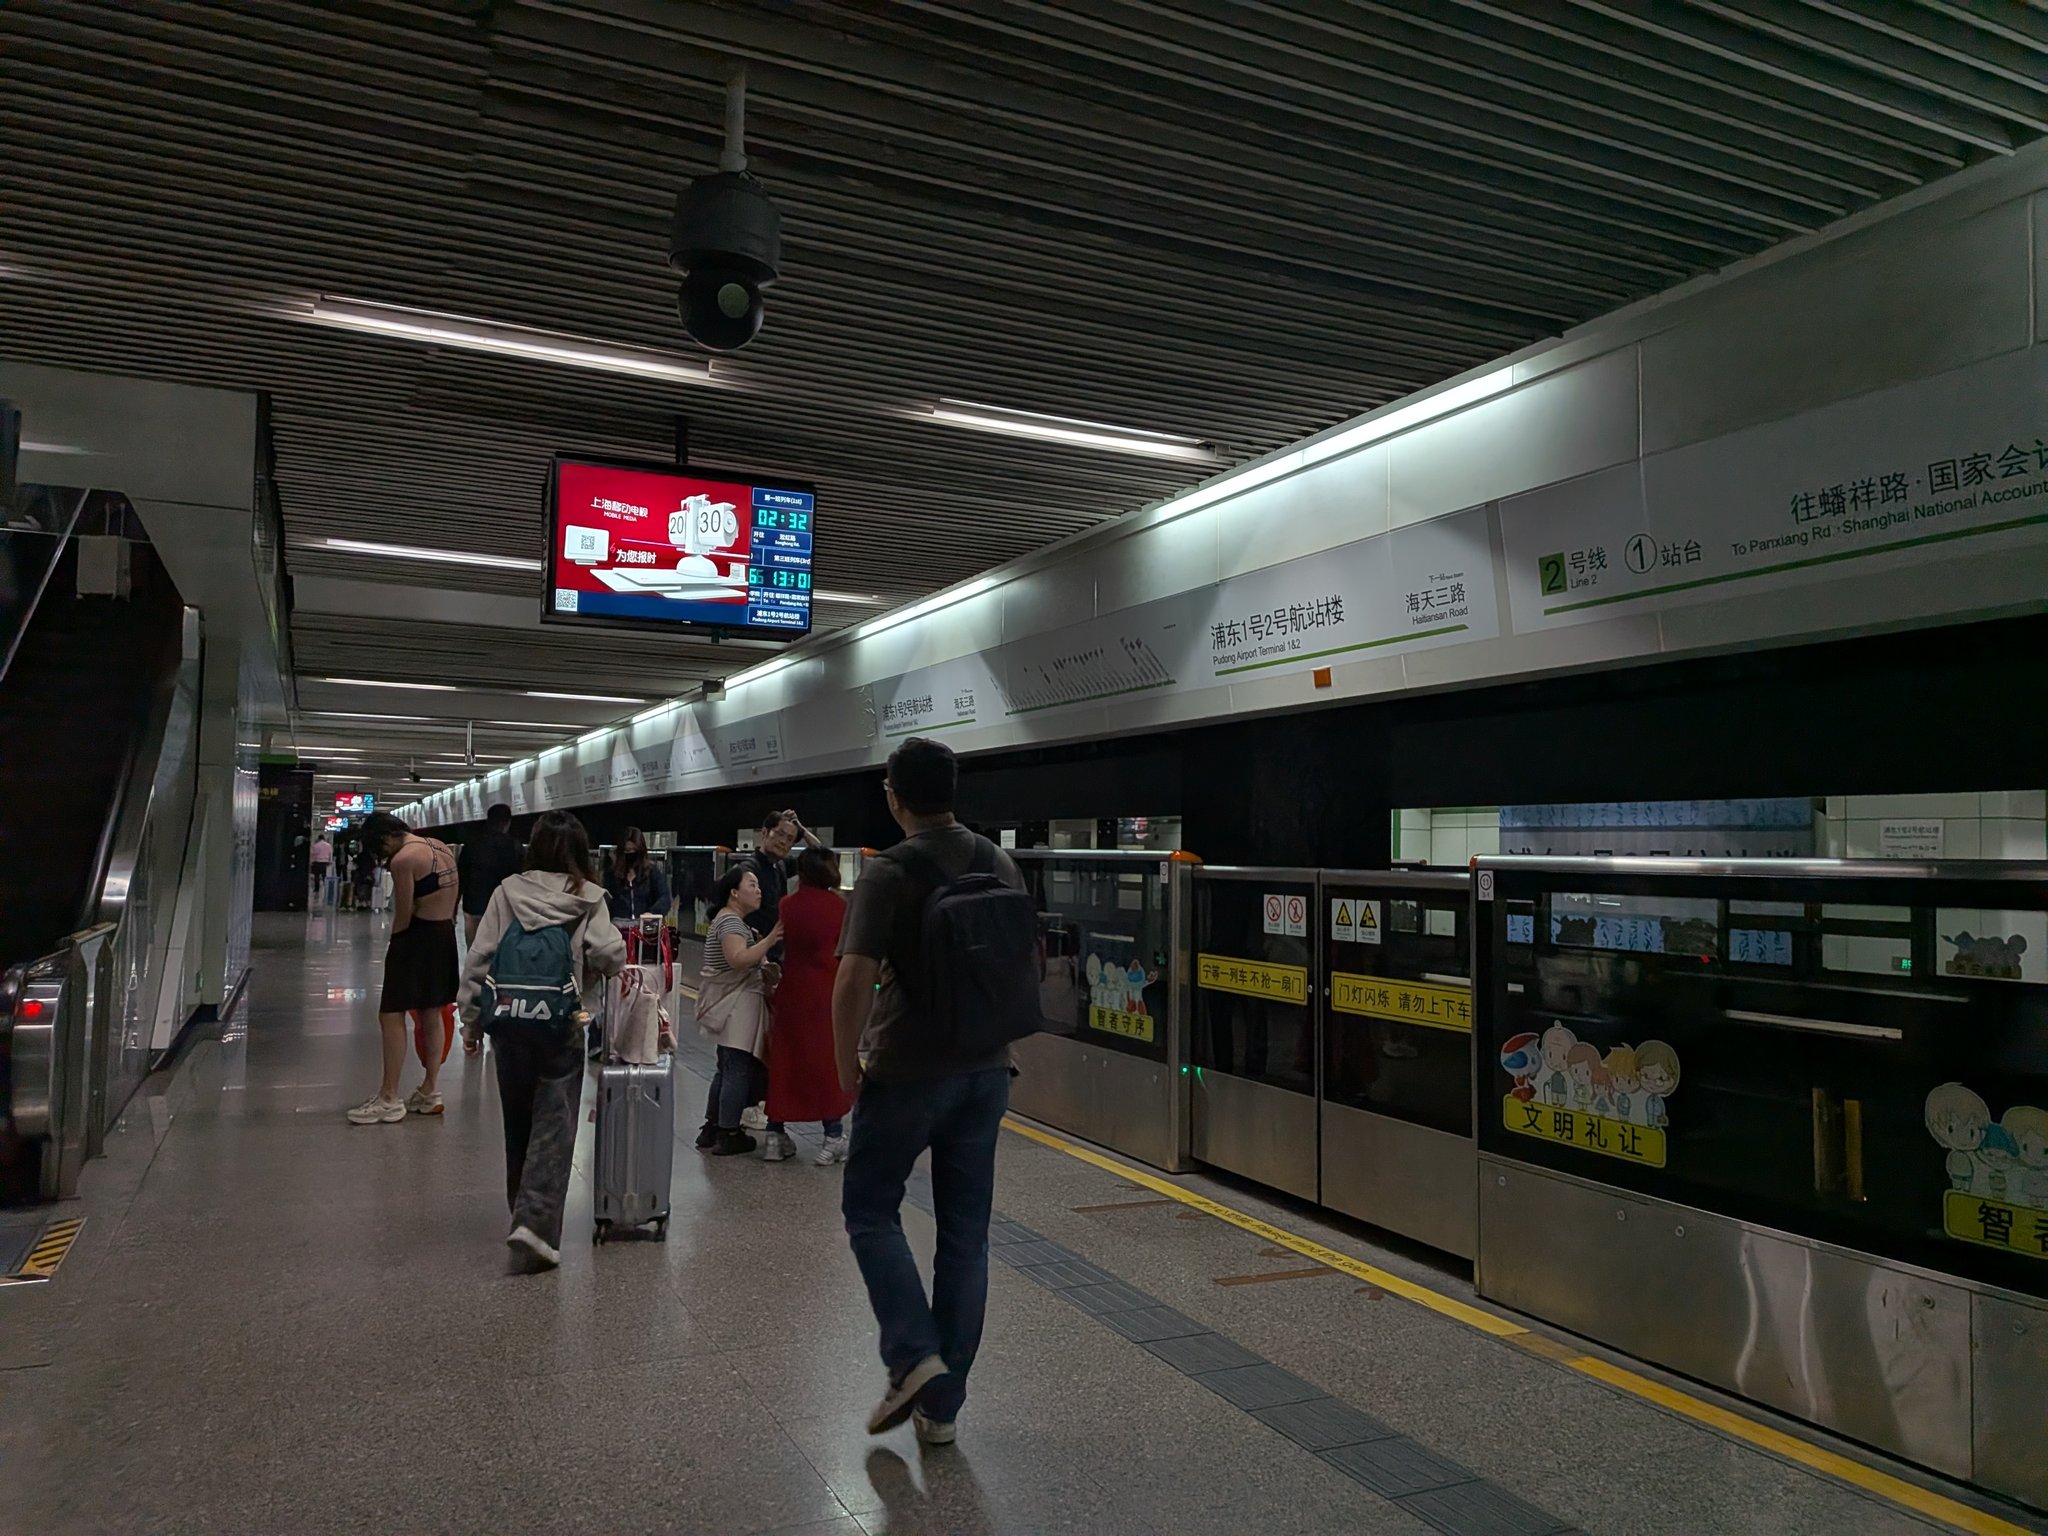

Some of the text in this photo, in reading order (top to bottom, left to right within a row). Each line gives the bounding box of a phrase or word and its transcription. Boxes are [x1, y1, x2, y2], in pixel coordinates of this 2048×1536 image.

[603, 511, 638, 522] MOBILE MEDIA
[669, 510, 721, 535] 20 30
[758, 509, 807, 530] 02:32
[1731, 543, 1747, 556] To
[1749, 531, 1809, 553] Panxiang
[1914, 493, 1977, 519] National
[615, 549, 657, 564] 为您报时
[1570, 574, 1598, 589] Line 2
[1406, 582, 1466, 613] 海天三路
[1211, 594, 1345, 650] 浦东1号2号航站楼
[1448, 605, 1469, 618] Road
[1213, 638, 1302, 665] Pudong Airport Terminal 1&2
[494, 998, 552, 1020] FILA
[1339, 983, 1470, 1021] 门灯闪烁 请勿上下车
[1097, 1009, 1145, 1036] 智者守序
[1521, 1104, 1643, 1156] 文明礼让
